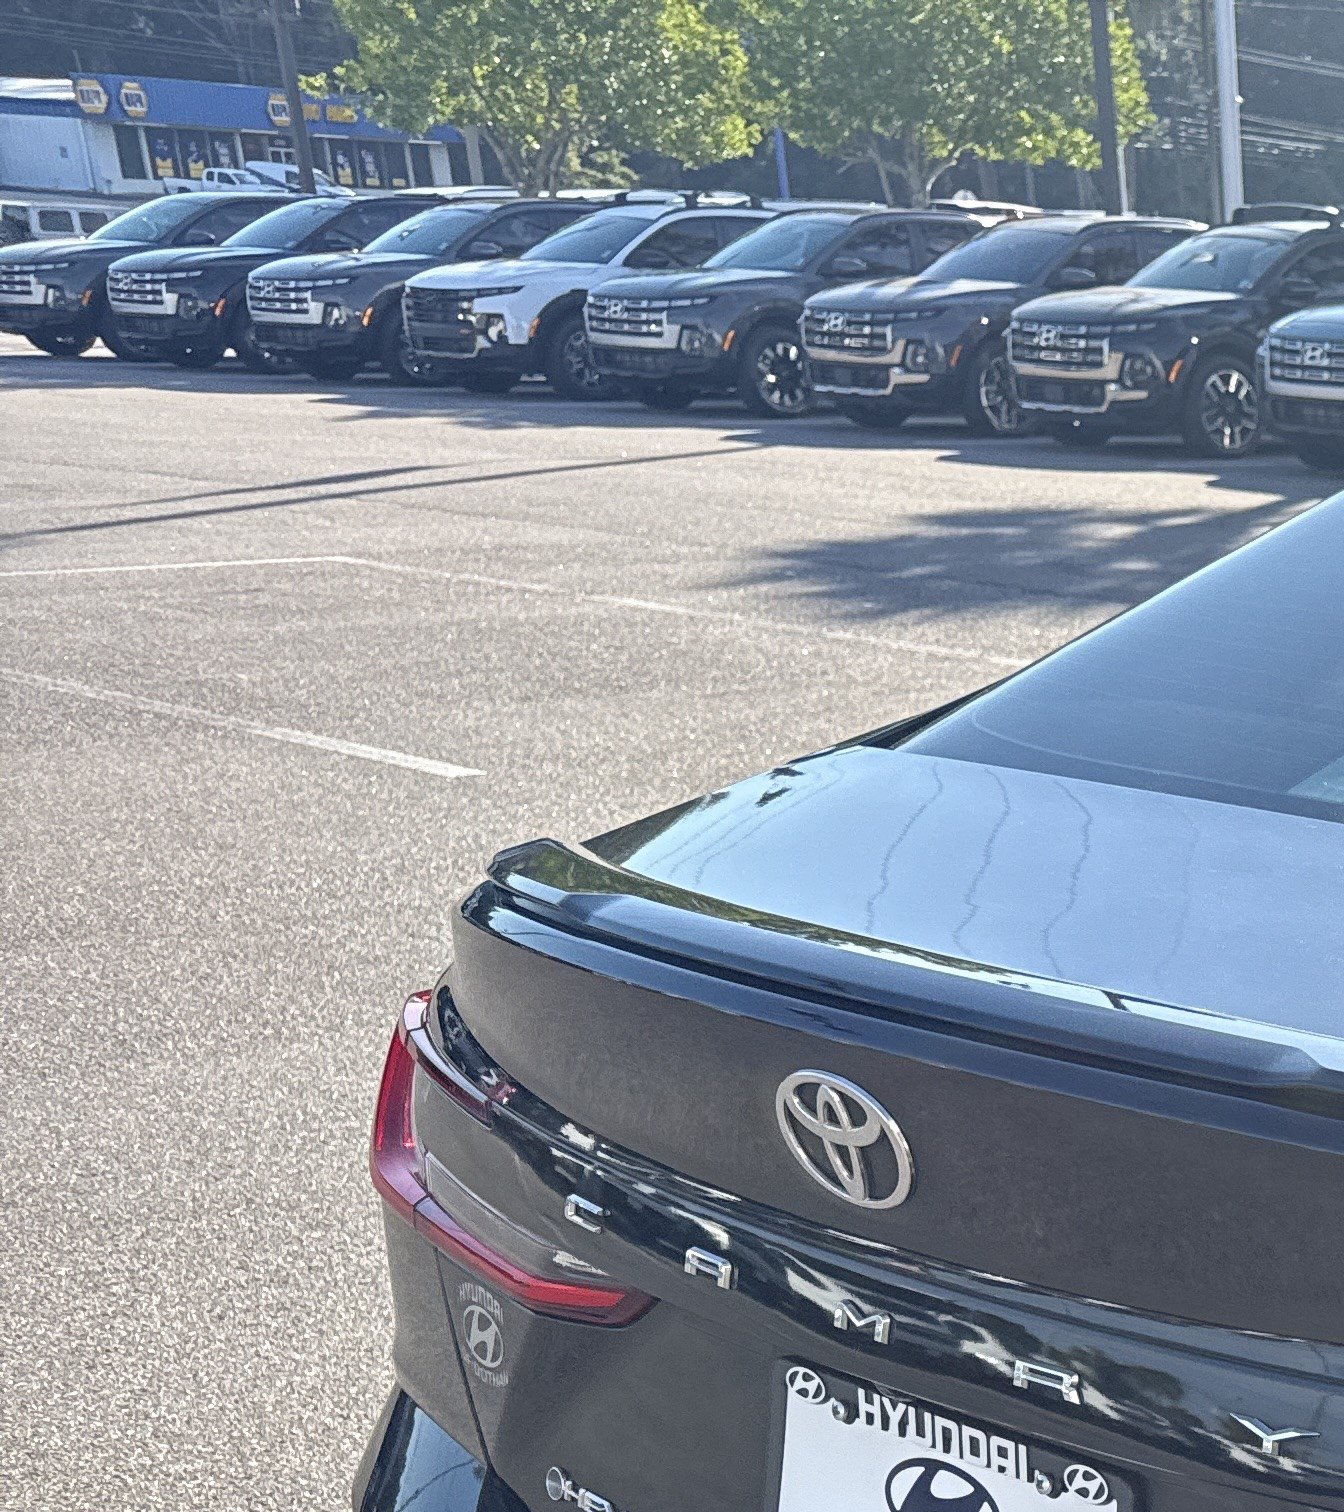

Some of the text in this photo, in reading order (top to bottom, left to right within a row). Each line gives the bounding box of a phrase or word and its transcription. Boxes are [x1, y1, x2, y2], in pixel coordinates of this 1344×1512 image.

[458, 1282, 504, 1324] HYUNDAI
[563, 1192, 1322, 1457] CAMRY
[856, 1387, 1030, 1484] HYUNDAI
